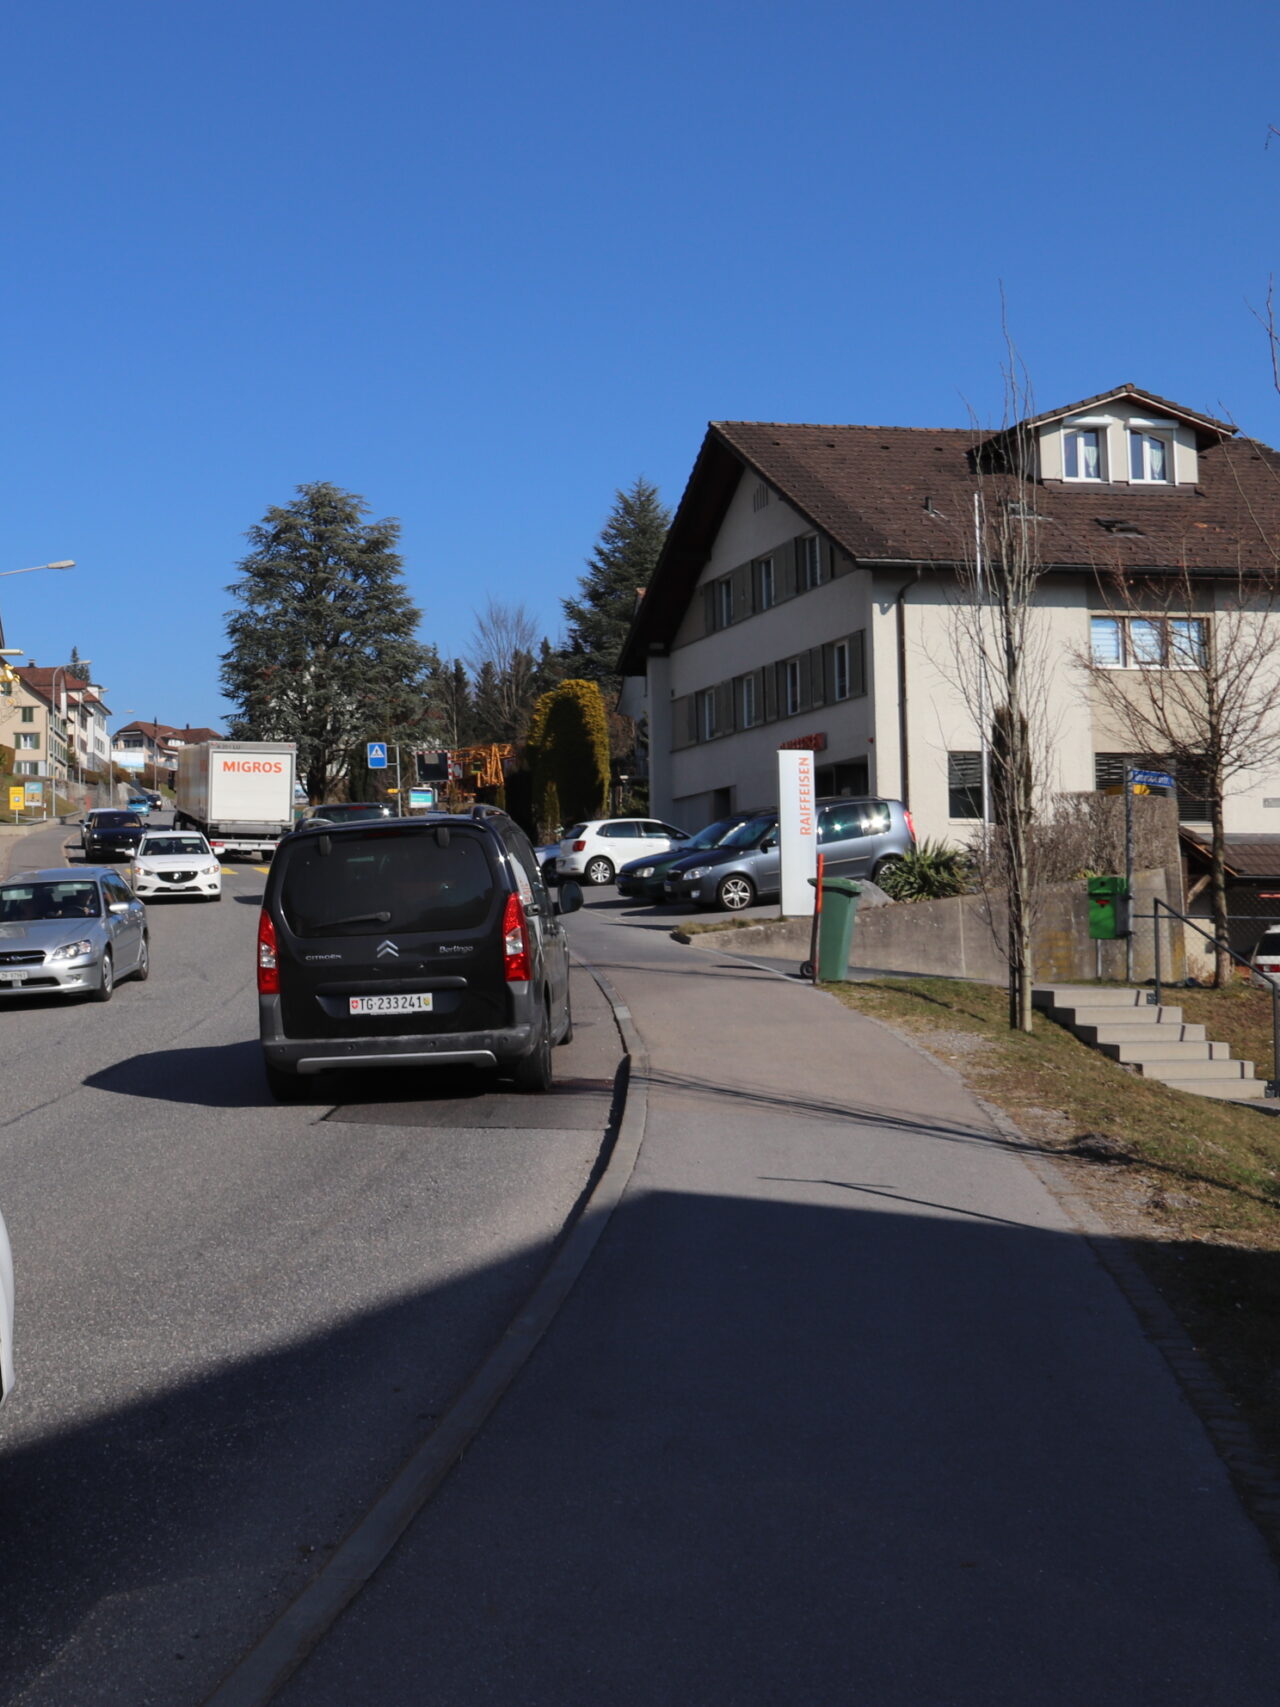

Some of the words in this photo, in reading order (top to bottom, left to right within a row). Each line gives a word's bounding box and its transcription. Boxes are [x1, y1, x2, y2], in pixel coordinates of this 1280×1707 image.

[223, 761, 283, 773] MIGROS
[799, 757, 812, 836] RAIFFEISEN
[439, 945, 474, 953] Berlingo
